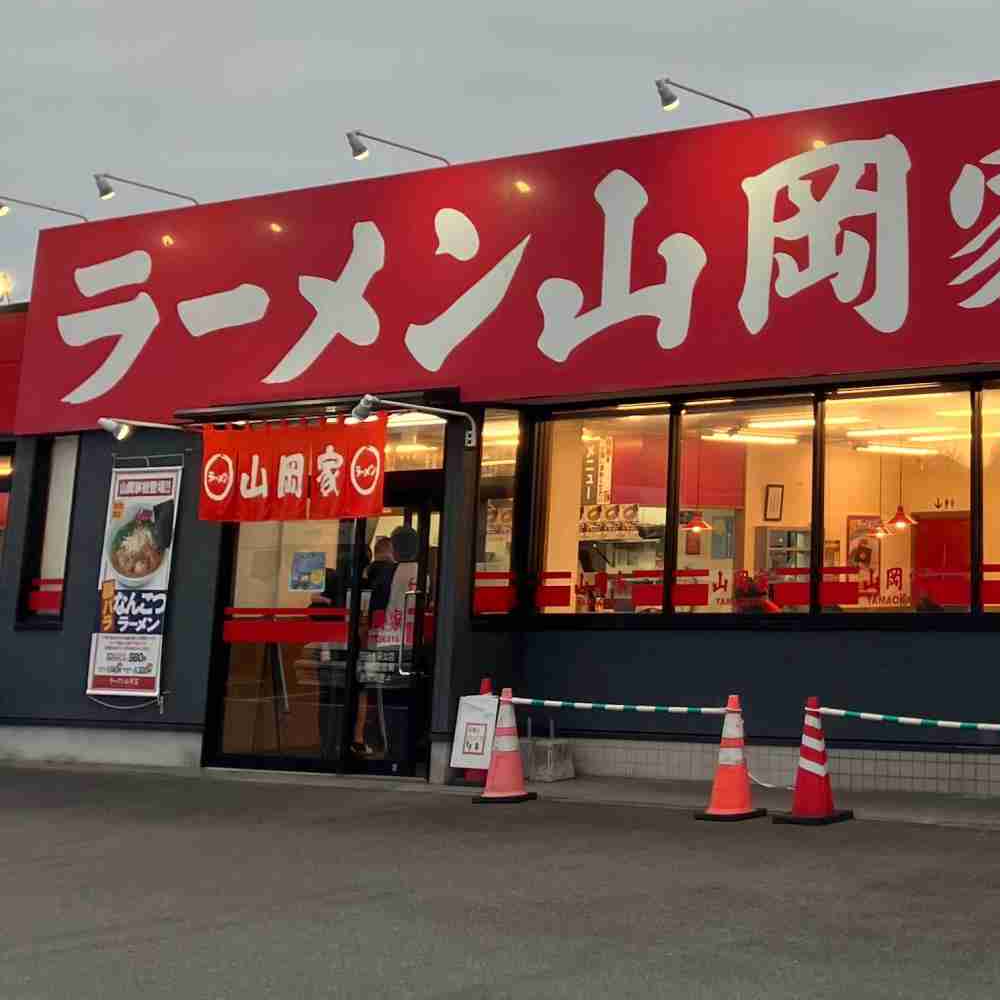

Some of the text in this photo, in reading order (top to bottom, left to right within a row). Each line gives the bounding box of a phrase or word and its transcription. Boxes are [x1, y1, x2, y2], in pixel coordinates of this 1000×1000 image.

[239, 444, 345, 499] 山岡家
[114, 591, 167, 616] なんこつ
[116, 616, 160, 632] ラーメン
